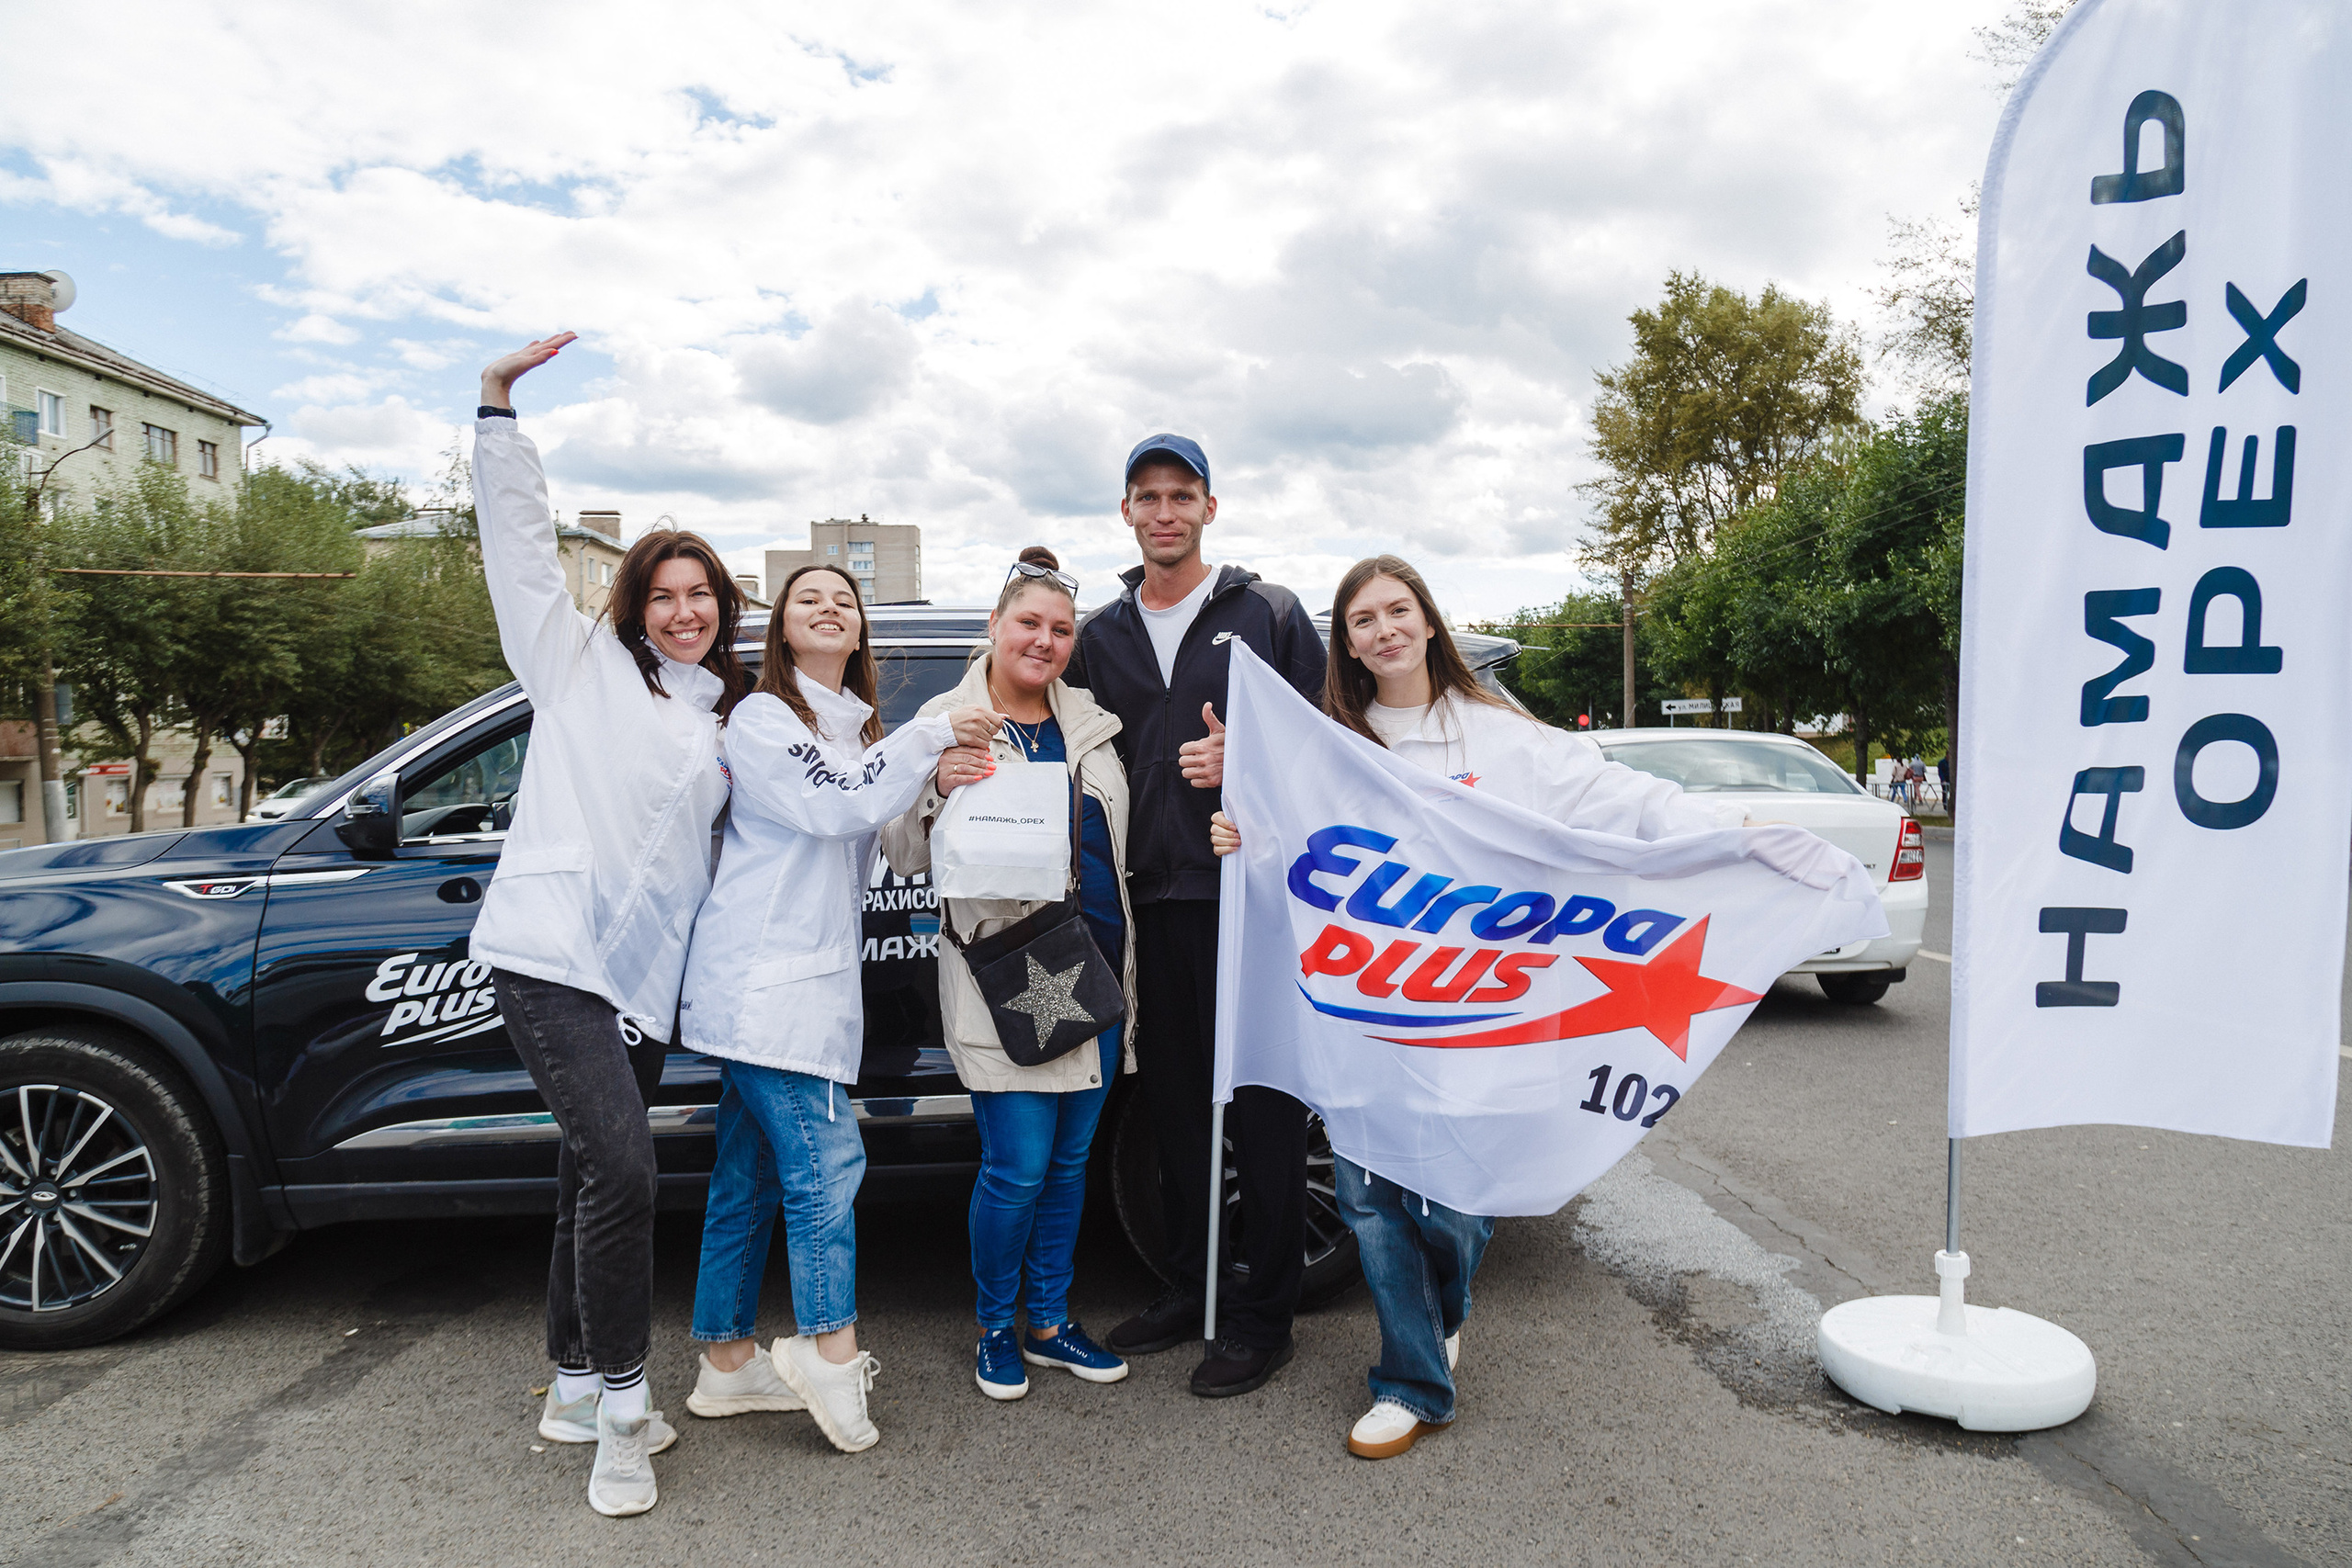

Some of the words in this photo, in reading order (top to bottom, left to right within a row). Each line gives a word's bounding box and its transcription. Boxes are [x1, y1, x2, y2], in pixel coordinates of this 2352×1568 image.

[2035, 89, 2189, 1008] НАМАЖЬ
[2173, 277, 2308, 830] ОРЕХ
[862, 887, 943, 912] РАХИСО
[1286, 824, 1688, 956] Europa
[365, 952, 494, 1003] Euro
